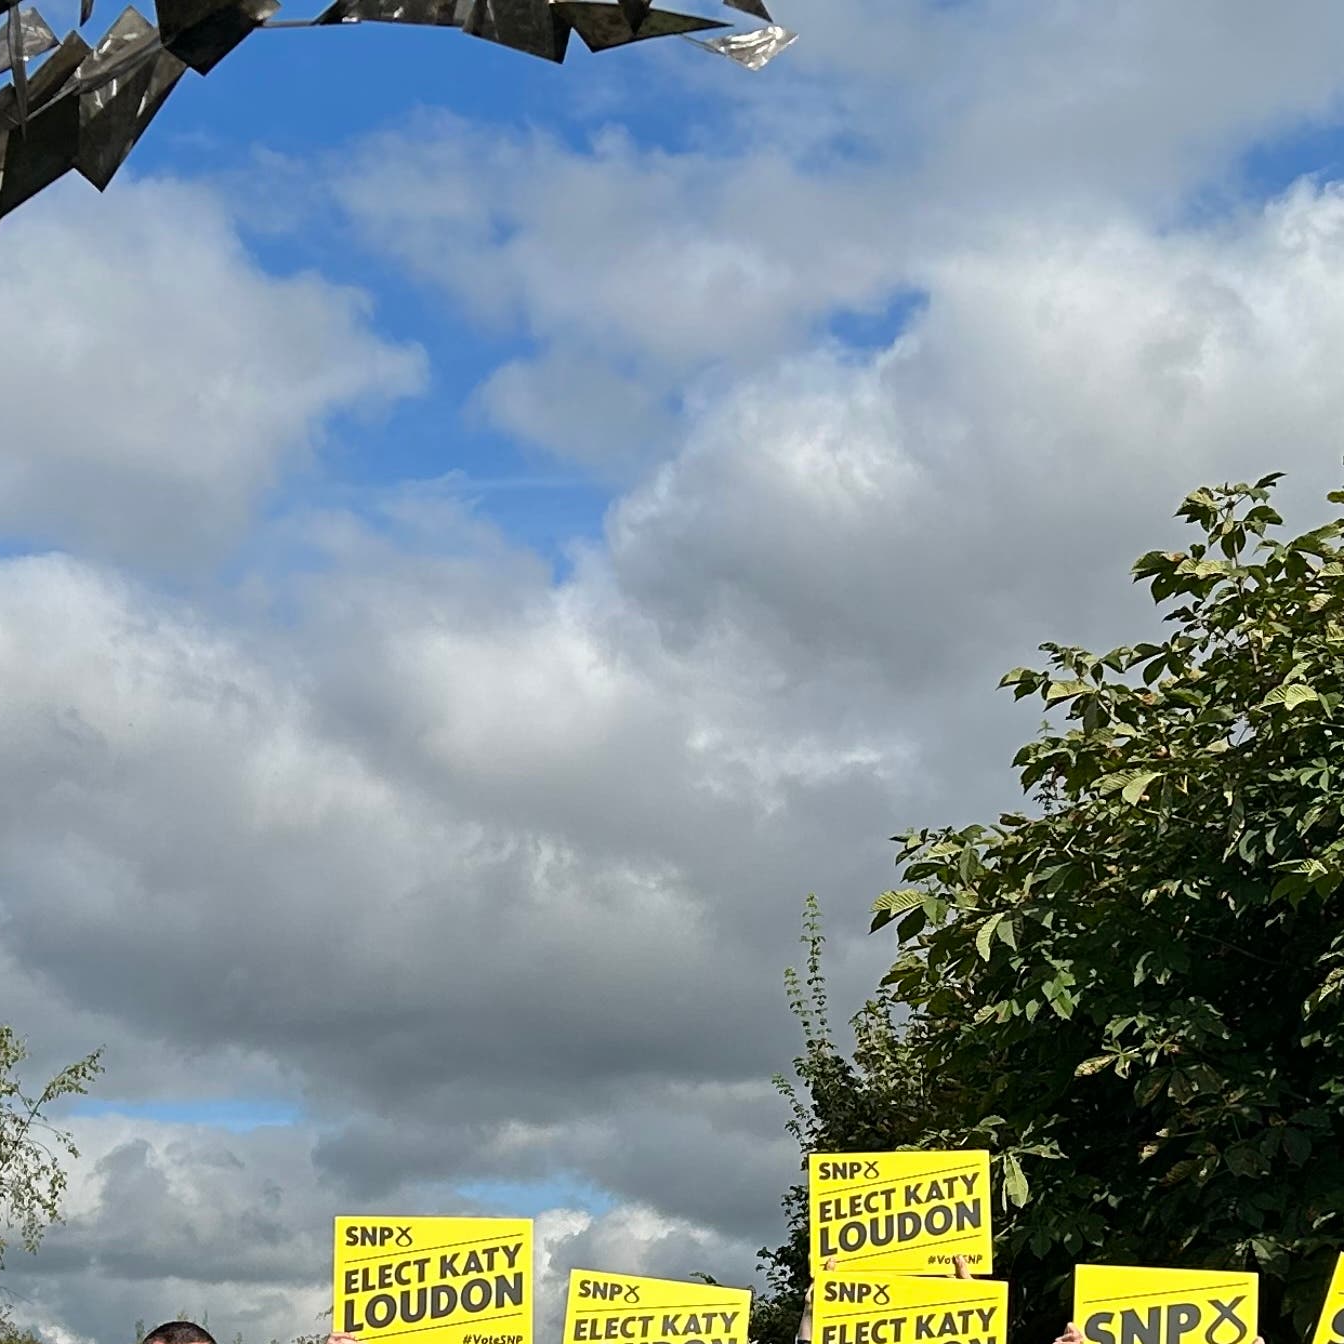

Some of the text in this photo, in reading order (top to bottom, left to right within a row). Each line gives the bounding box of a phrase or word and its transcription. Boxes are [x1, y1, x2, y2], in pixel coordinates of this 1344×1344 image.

[819, 1161, 862, 1180] SNP
[819, 1172, 980, 1223] ELECT KATY
[346, 1226, 393, 1246] SNP
[819, 1198, 981, 1257] LOUDON
[345, 1242, 523, 1294] ELECT KATY
[344, 1272, 523, 1333] LOUDON
[578, 1280, 622, 1301] SNP
[824, 1281, 872, 1304] SNP
[573, 1311, 740, 1341] ELECT KATY
[916, 1306, 997, 1339] KATY
